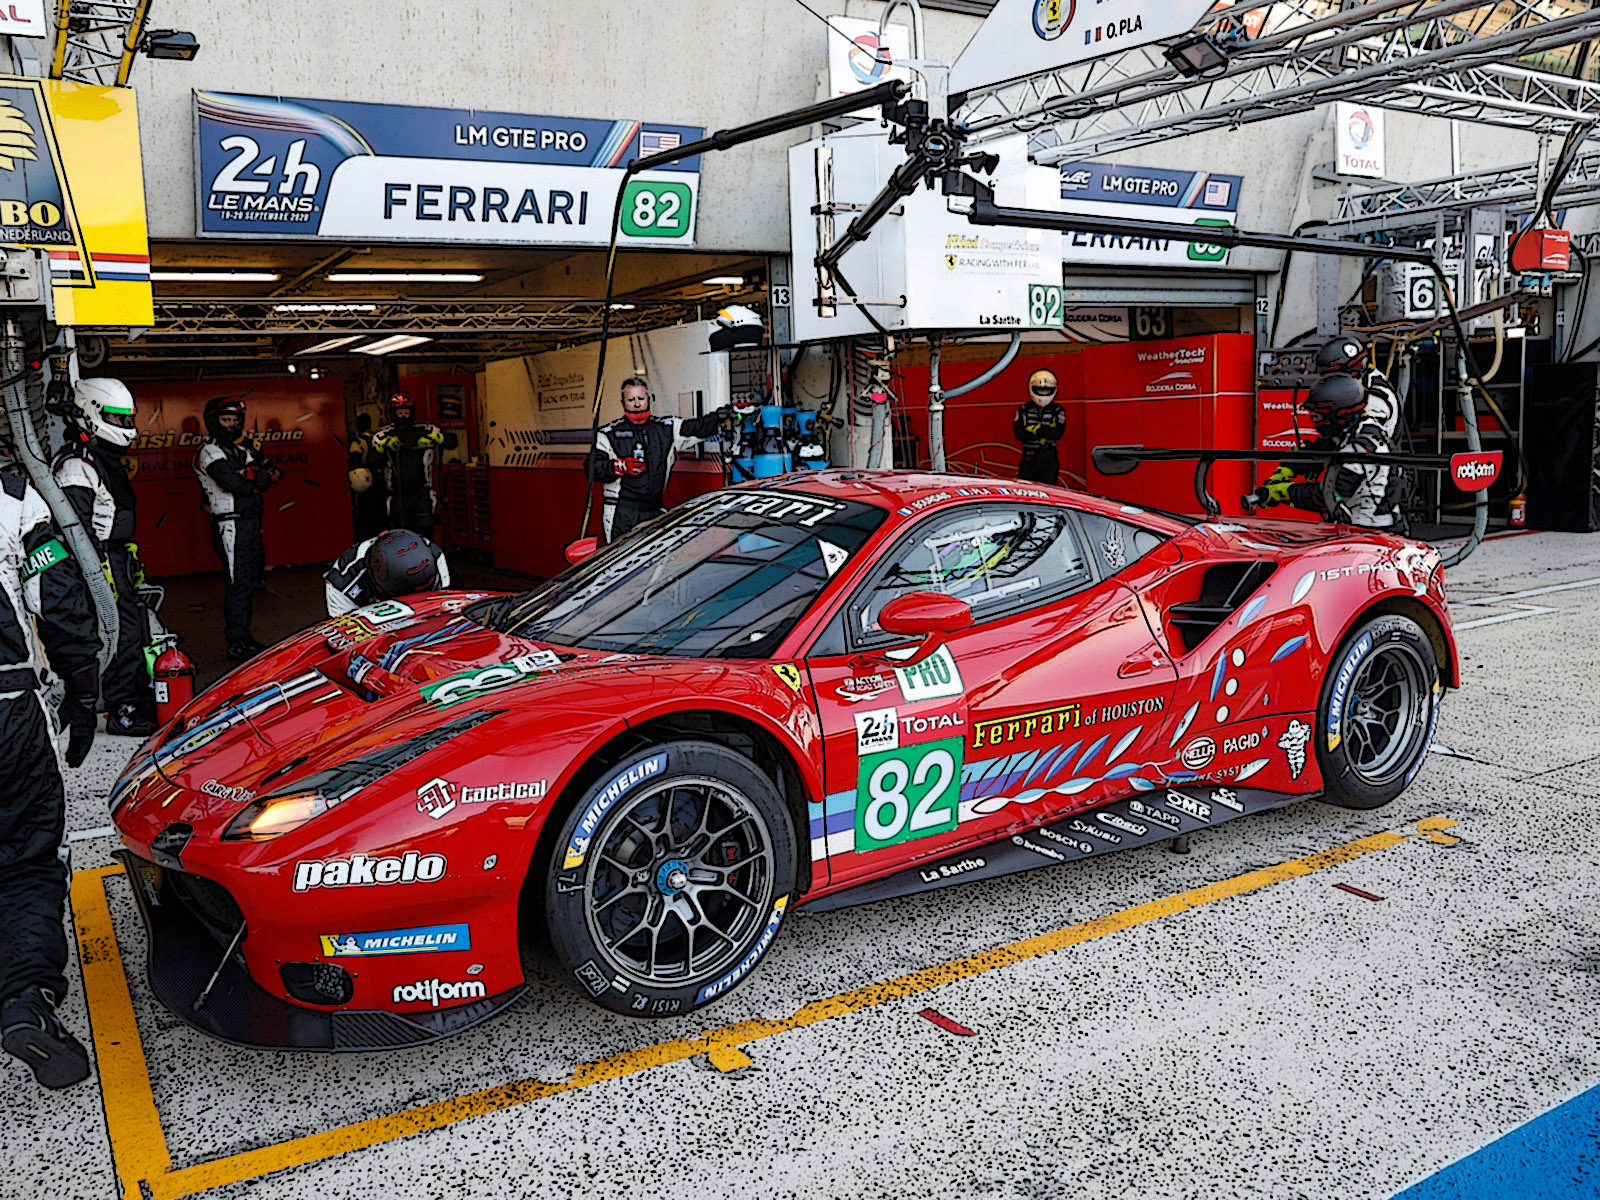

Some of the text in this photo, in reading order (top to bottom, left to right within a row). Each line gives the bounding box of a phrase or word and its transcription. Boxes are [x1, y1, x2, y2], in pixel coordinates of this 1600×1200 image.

[455, 125, 587, 152] LM GTE PRO
[212, 136, 321, 195] 24h
[1343, 155, 1380, 170] TOTAL
[1102, 175, 1178, 196] LM GTE PRO
[208, 194, 314, 212] LE MANS
[384, 183, 588, 225] FERRARI
[632, 190, 681, 228] 82
[945, 234, 979, 249] Risi
[773, 288, 790, 304] 13
[1031, 285, 1061, 326] 82
[1257, 300, 1268, 313] 12
[979, 315, 991, 325] La
[1135, 308, 1166, 336] 63
[1137, 347, 1206, 362] WeatherTech
[1320, 566, 1353, 582] 1ST
[902, 653, 950, 690] PRO
[1331, 638, 1370, 720] MICHELIN
[901, 713, 964, 735] TOTAL
[972, 695, 1165, 749] Ferrari of HOUSTON
[1184, 742, 1216, 761] HELLA
[1222, 732, 1260, 755] PAGID
[460, 778, 548, 804] tactical
[581, 757, 660, 836] MICHELIN
[863, 748, 955, 842] 82
[1166, 792, 1211, 818] OMP
[1039, 827, 1079, 849] BOSCH
[295, 852, 446, 891] pakelo
[919, 870, 941, 883] La
[363, 931, 458, 949] MICHELIN
[703, 928, 774, 997] MICHELIN
[391, 979, 487, 1006] rotiform
